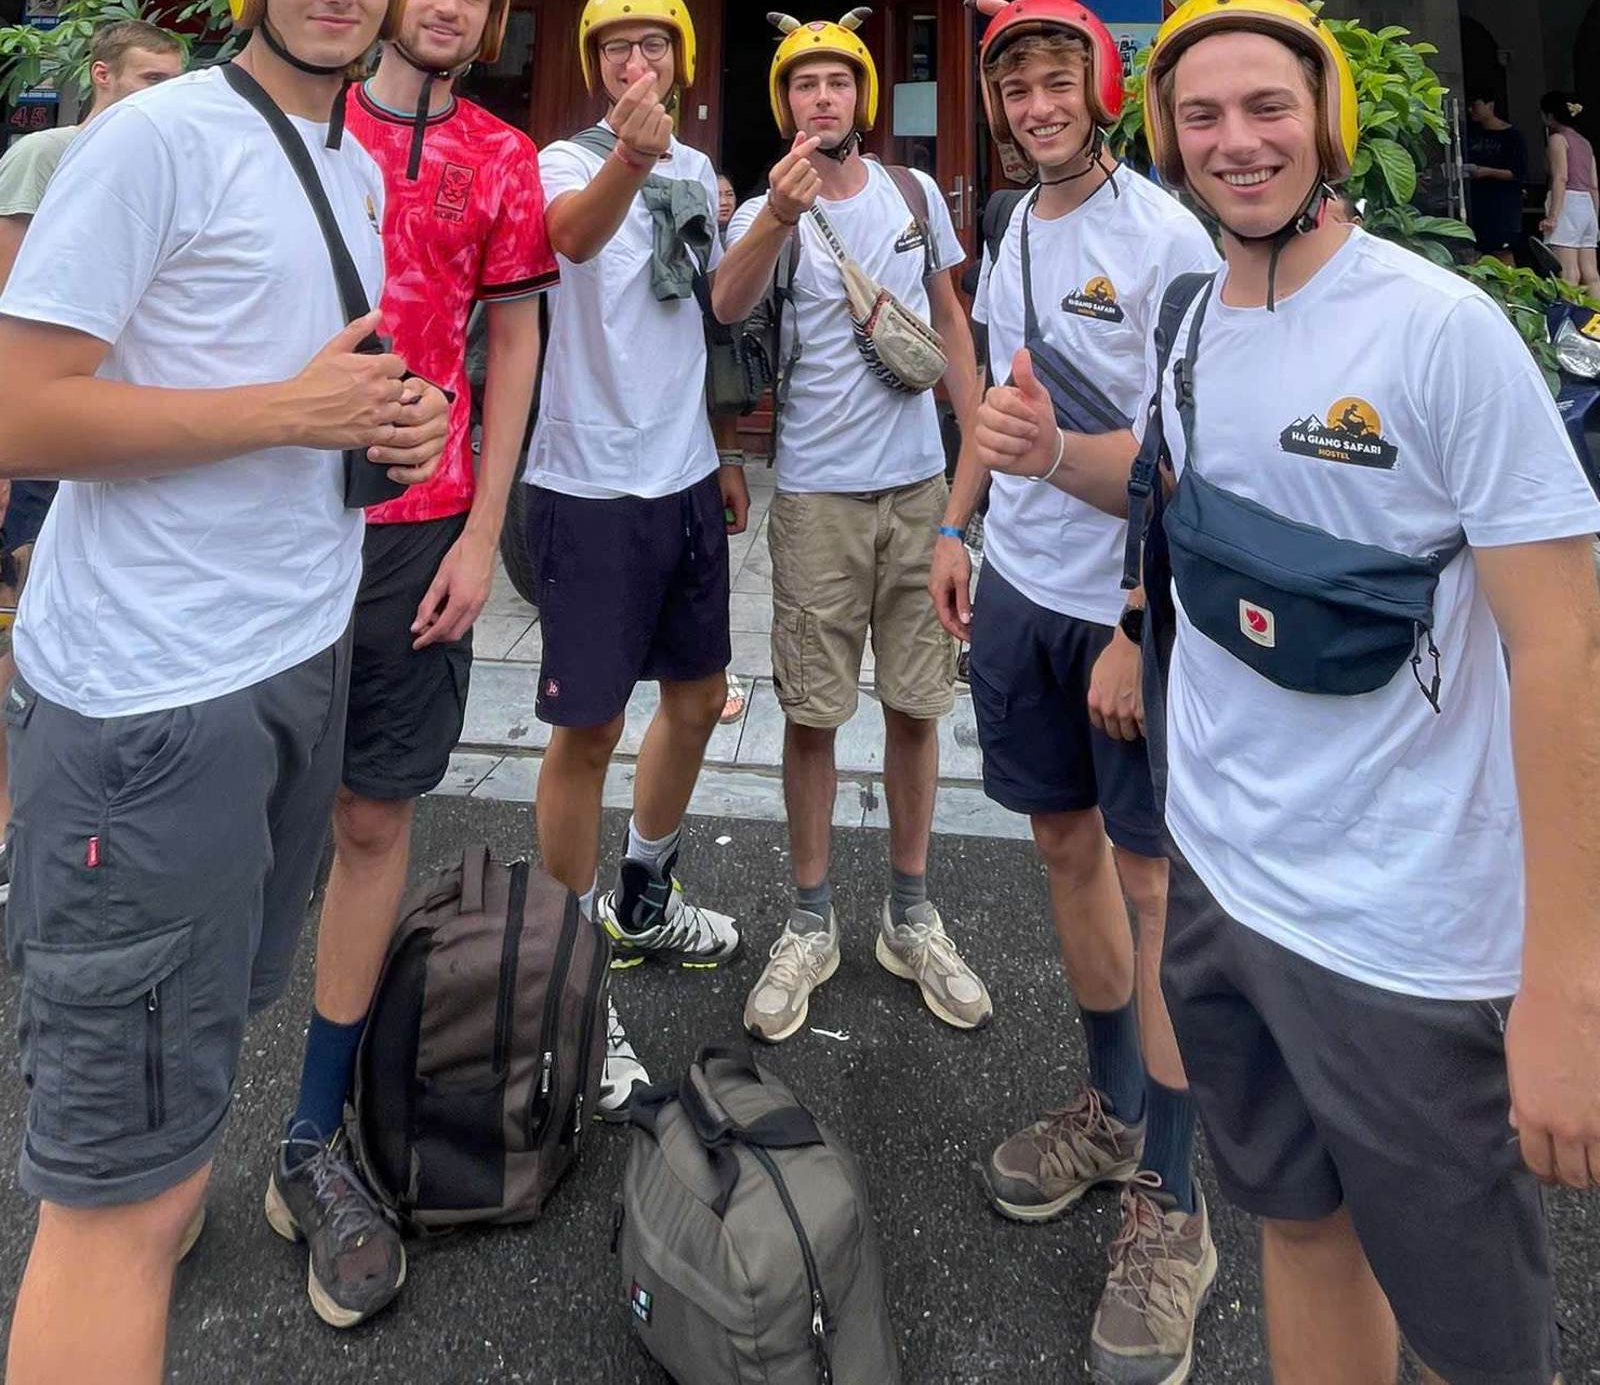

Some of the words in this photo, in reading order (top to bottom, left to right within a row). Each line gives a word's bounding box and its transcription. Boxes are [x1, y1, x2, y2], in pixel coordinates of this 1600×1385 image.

[1292, 431, 1305, 442] HA
[1307, 434, 1342, 448] GIANG
[1343, 439, 1381, 455] SAFARI
[1318, 448, 1350, 460] HOSTEL
